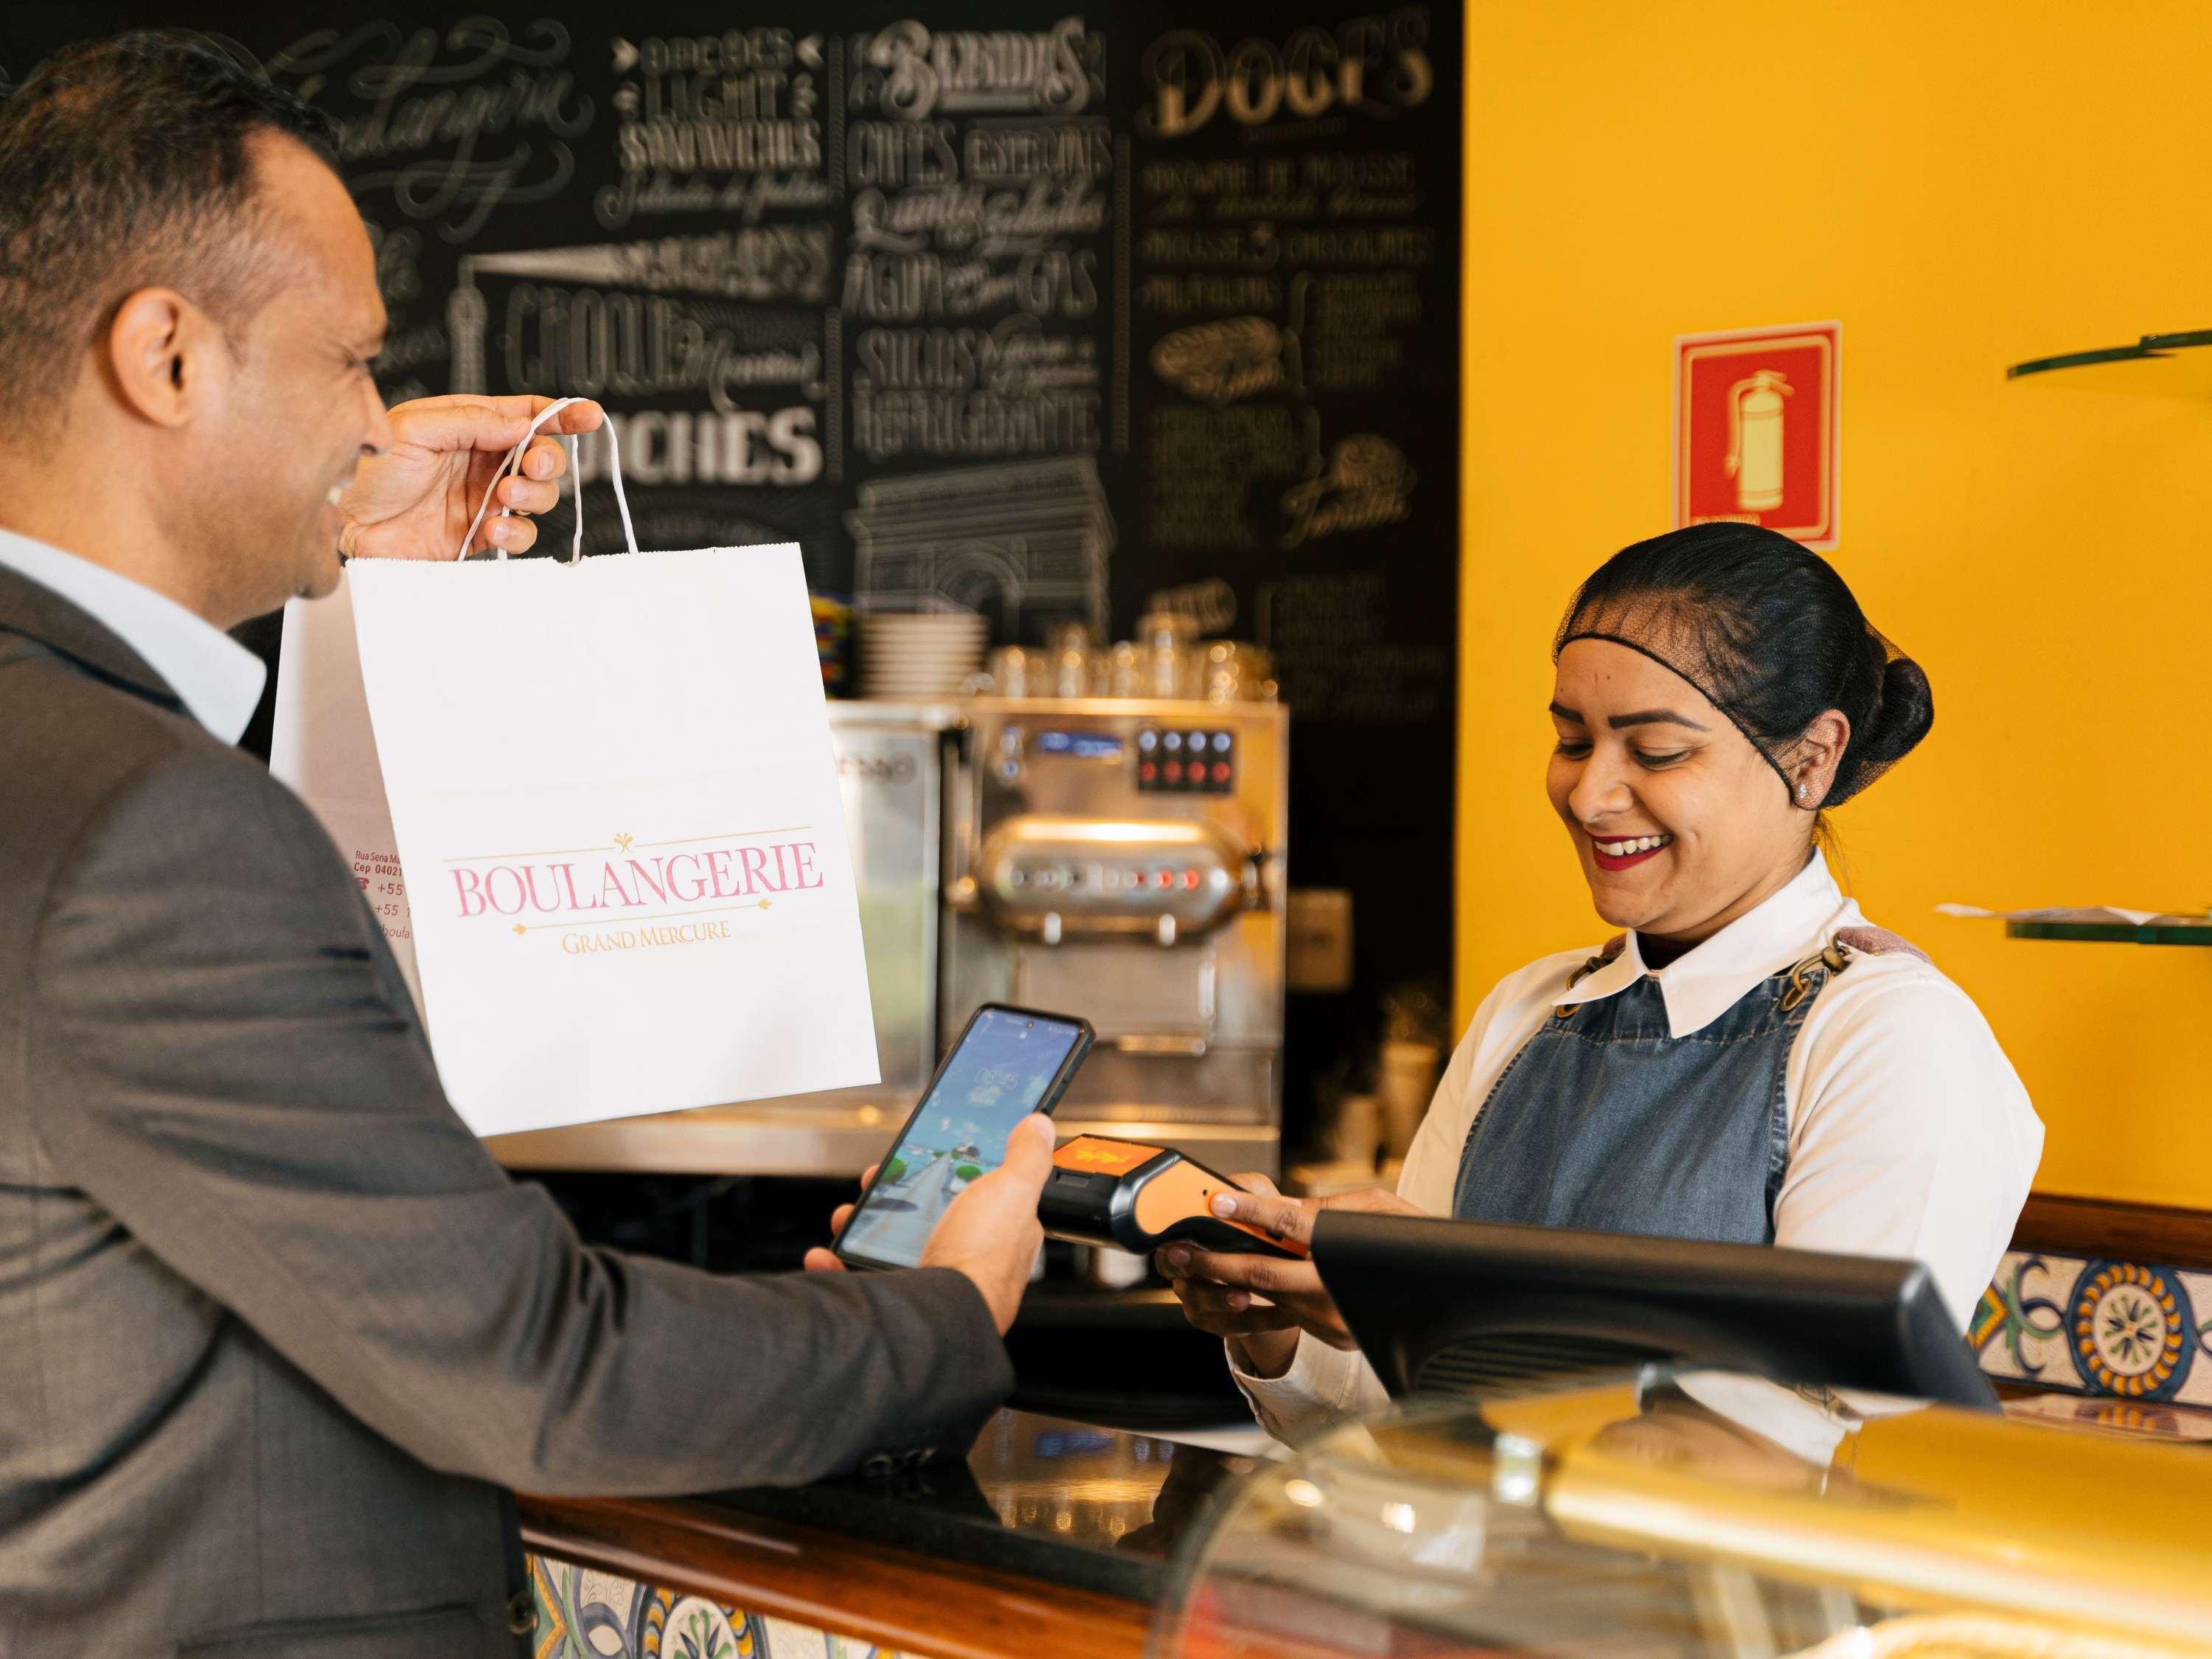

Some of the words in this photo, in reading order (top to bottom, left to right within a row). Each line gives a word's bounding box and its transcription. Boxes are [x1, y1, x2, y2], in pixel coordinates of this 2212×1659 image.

[1135, 7, 1434, 136] DOCES
[355, 851, 369, 860] Rua
[370, 852, 389, 863] Sena
[354, 862, 370, 874] Cep
[448, 842, 824, 918] BOULANGERIE
[377, 882, 404, 896] +55
[375, 903, 399, 916] +55
[562, 932, 637, 955] GRAND
[639, 919, 731, 947] MERCURE
